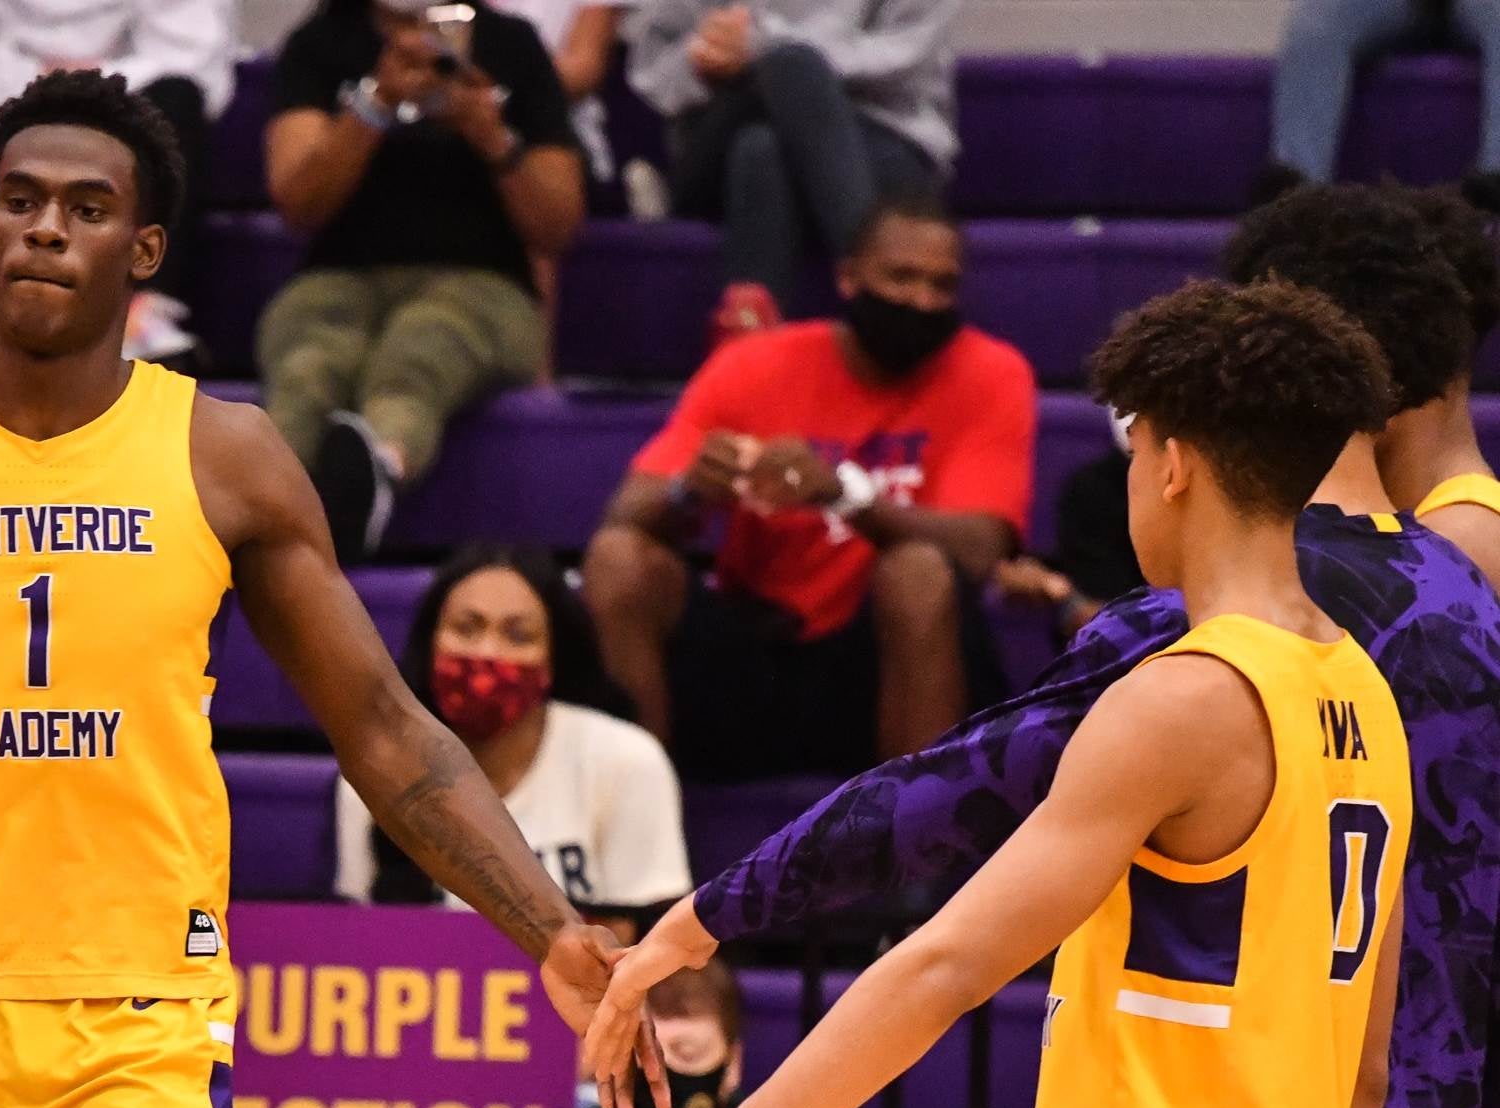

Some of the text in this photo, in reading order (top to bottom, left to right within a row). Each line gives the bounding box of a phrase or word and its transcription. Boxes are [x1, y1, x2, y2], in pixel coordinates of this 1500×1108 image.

[18, 571, 54, 690] 1
[1326, 797, 1393, 985] 0
[233, 963, 532, 1062] URPLE
